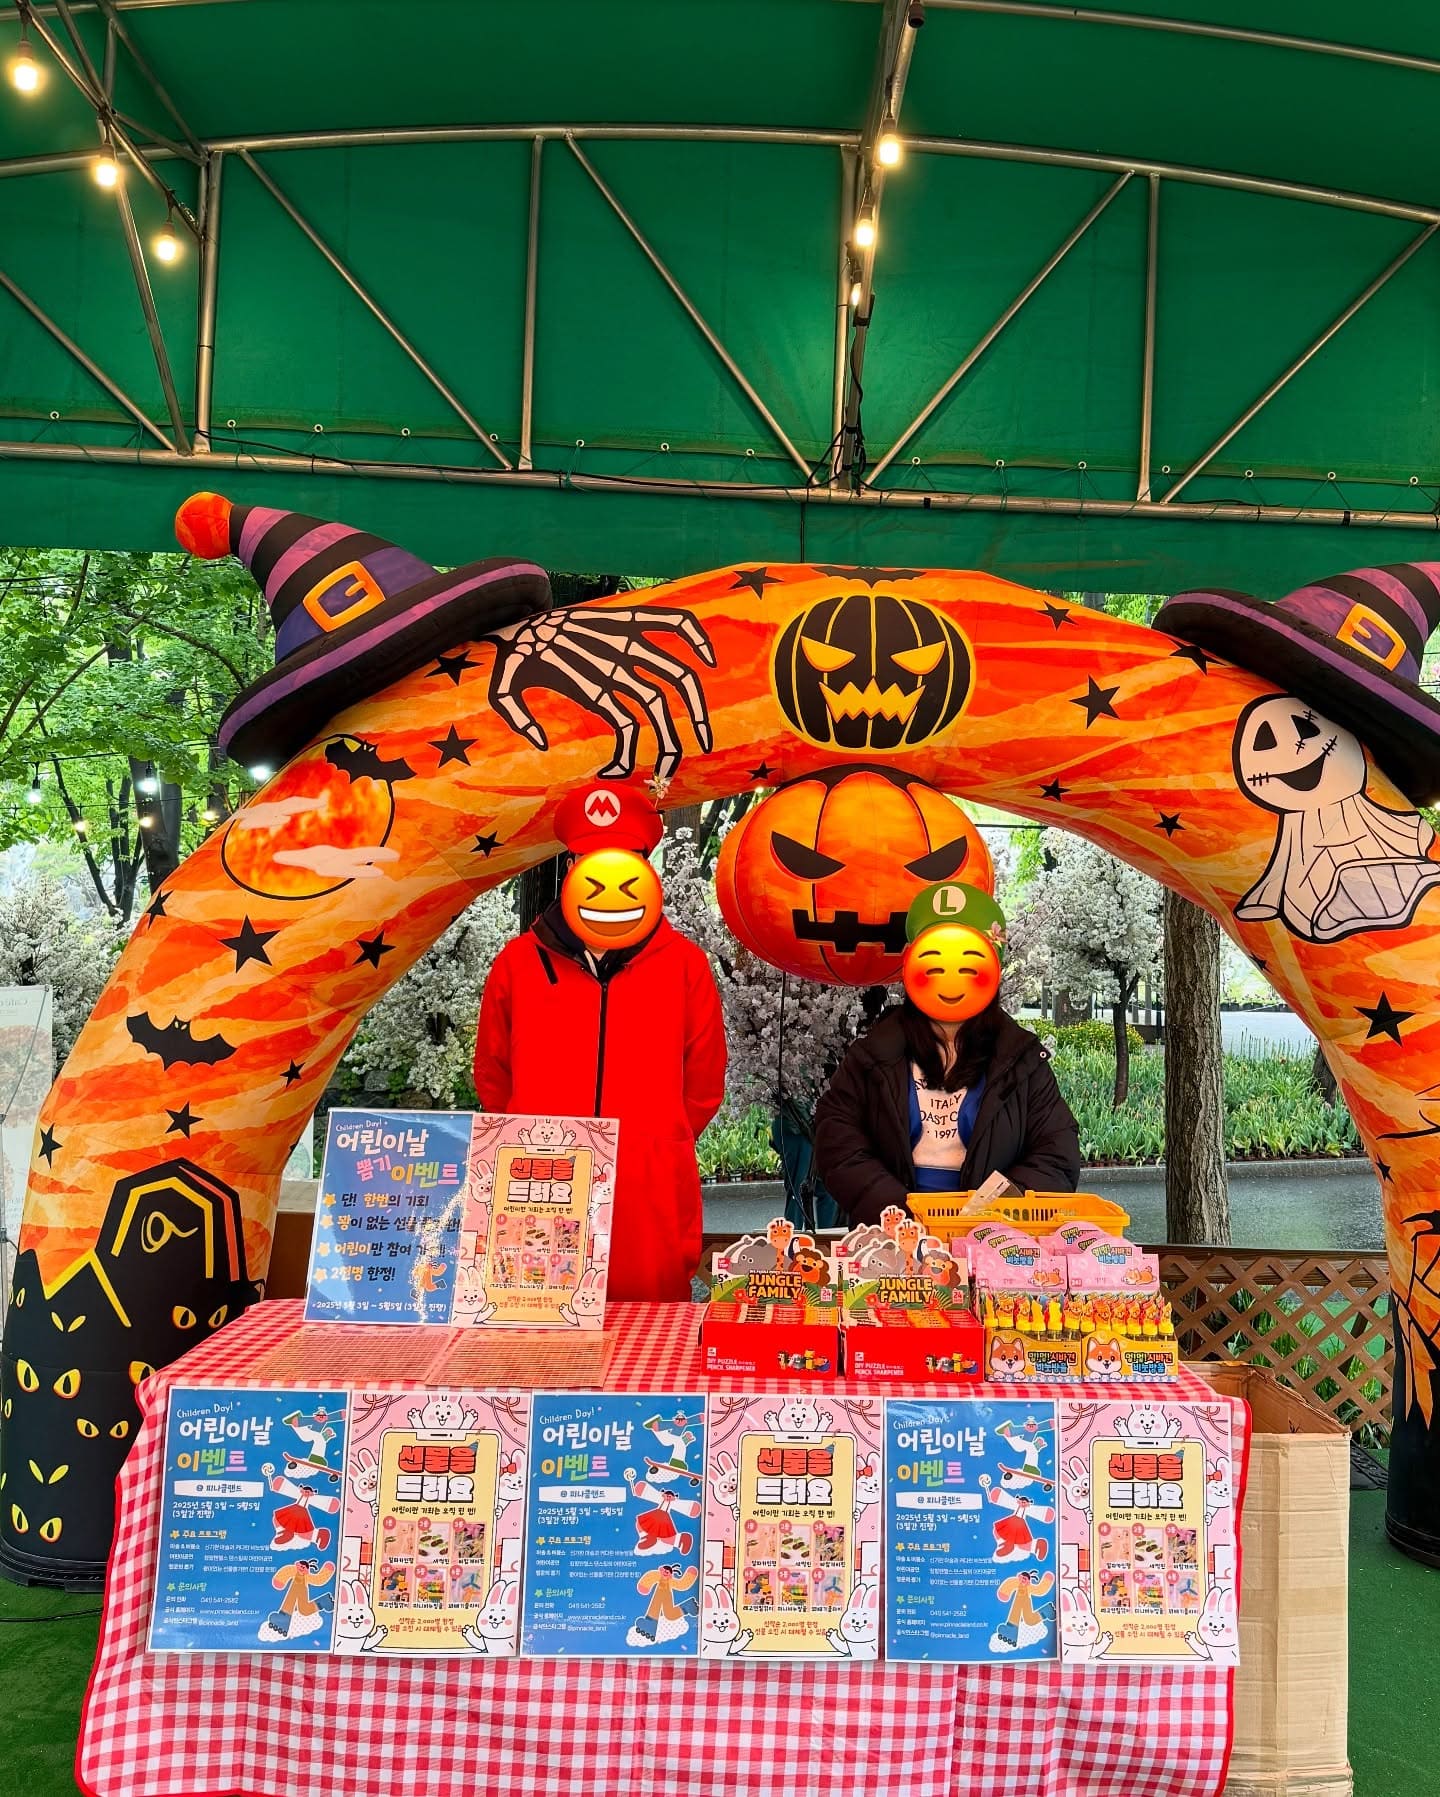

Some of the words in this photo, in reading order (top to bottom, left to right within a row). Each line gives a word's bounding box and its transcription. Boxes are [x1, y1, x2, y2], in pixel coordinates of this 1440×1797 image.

[587, 796, 618, 817] M
[940, 889, 957, 912] L
[931, 1094, 962, 1109] ITALY
[336, 1123, 364, 1132] Children
[366, 1118, 382, 1128] Day!
[935, 1128, 957, 1139] 1997
[337, 1128, 429, 1157] 어린이날
[356, 1154, 392, 1182] 뽑기
[391, 1161, 460, 1188] 이벤트
[510, 1157, 574, 1181] 선물을
[341, 1193, 357, 1207] 단!
[363, 1192, 400, 1208] 한번의
[405, 1195, 429, 1207] 기회
[507, 1181, 573, 1204] 드려요
[337, 1214, 362, 1231] 꽝이
[366, 1215, 390, 1231] 없는
[334, 1241, 383, 1257] 어린이만
[387, 1242, 412, 1257] 참여
[331, 1266, 364, 1281] 2천명
[367, 1266, 396, 1281] 한정!
[718, 1273, 729, 1283] 5+
[748, 1274, 802, 1288] JUNGLE
[849, 1278, 859, 1288] 5+
[879, 1278, 933, 1291] JUNGLE
[748, 1286, 800, 1299] FAMILY
[822, 1289, 831, 1297] 24
[880, 1290, 932, 1303] FAMILY
[1035, 1361, 1068, 1374] 비눗방울
[1132, 1362, 1166, 1374] 비눗방울
[177, 1407, 211, 1419] Children
[214, 1401, 233, 1414] Day!
[539, 1412, 573, 1425] Children
[575, 1406, 595, 1419] Day!
[179, 1416, 274, 1446] 어린이날
[542, 1420, 634, 1451] 어린이날
[897, 1427, 987, 1457] 어린이날
[177, 1448, 248, 1476] 이벤트
[398, 1445, 477, 1474] 선물을
[541, 1453, 610, 1481] 이벤트
[757, 1447, 834, 1476] 선물을
[1109, 1453, 1183, 1480] 선물을
[897, 1459, 965, 1487] 이벤트
[206, 1484, 243, 1494] 피나클랜드
[396, 1474, 475, 1503] 드려요
[570, 1489, 606, 1499] 피나클랜드
[756, 1477, 832, 1506] 드려요
[1108, 1482, 1183, 1509] 드려요
[172, 1501, 200, 1510] 2025년
[215, 1501, 227, 1510] 3일
[926, 1495, 962, 1505] 피나클랜드
[172, 1510, 198, 1519] (3일간
[538, 1507, 563, 1516] 2025년
[579, 1507, 591, 1516] 3일
[896, 1513, 921, 1523] 2025년
[936, 1513, 948, 1523] 3일
[538, 1516, 561, 1525] (3일간
[896, 1522, 918, 1531] (3일간
